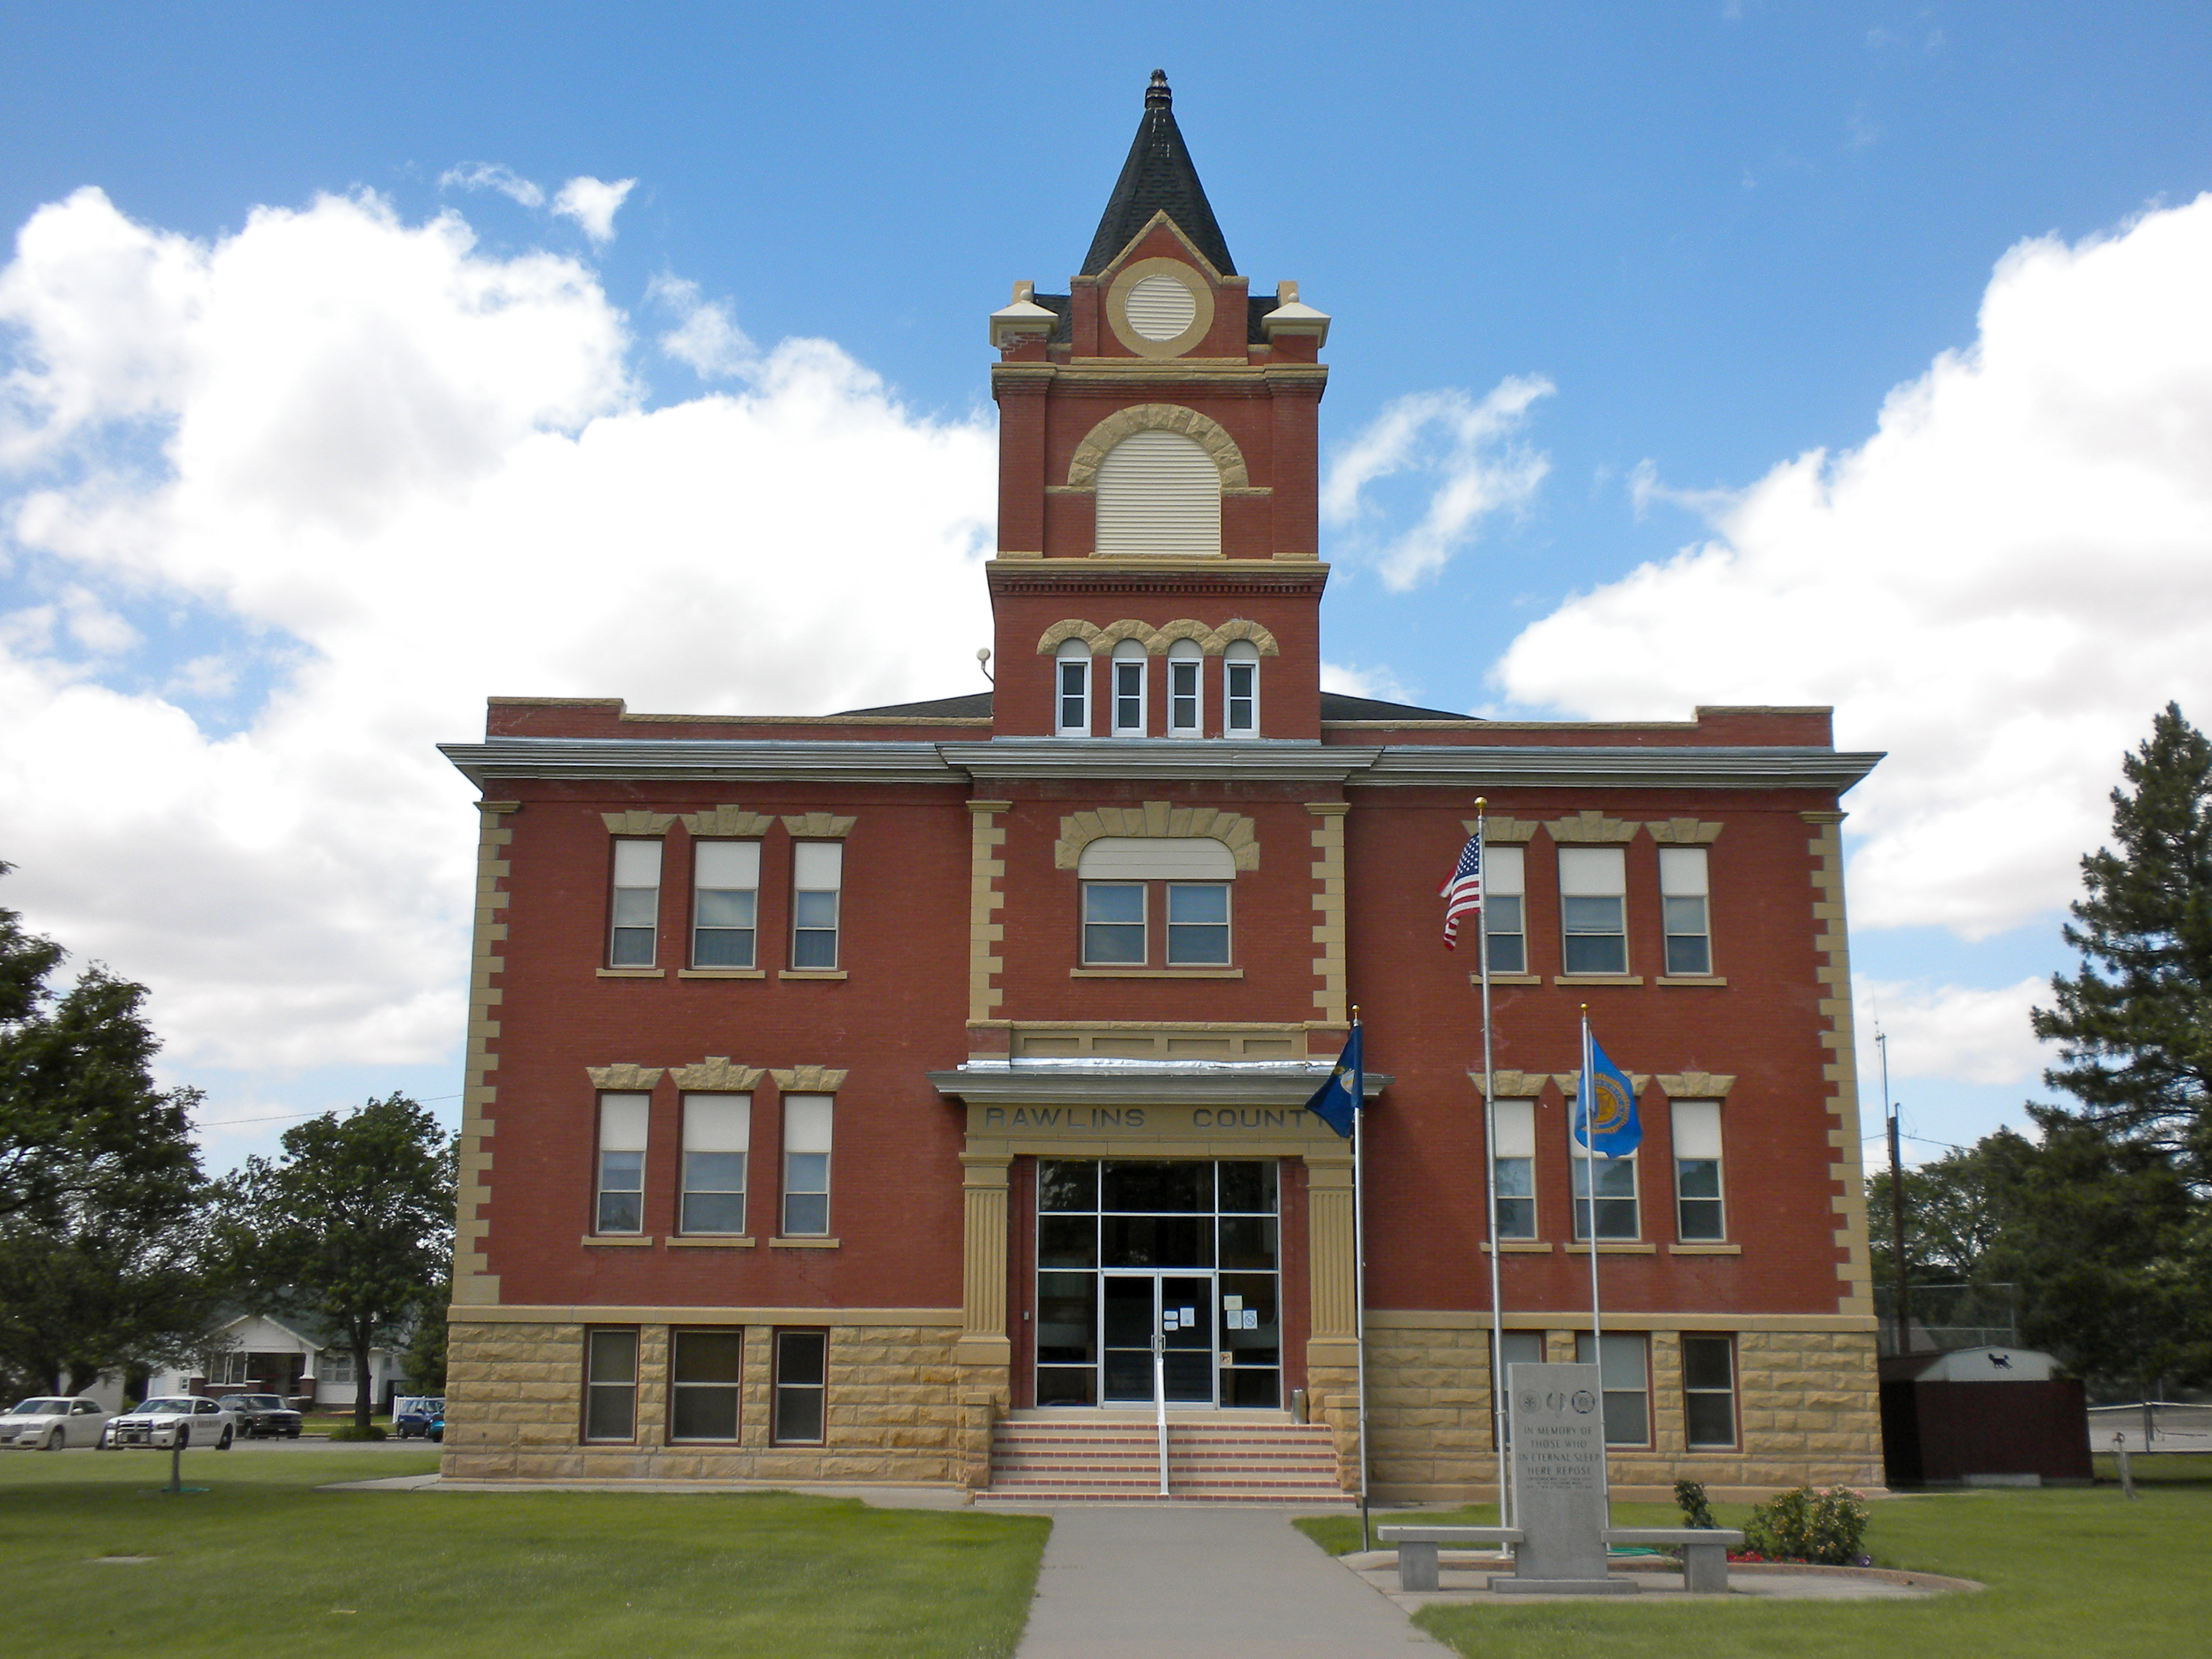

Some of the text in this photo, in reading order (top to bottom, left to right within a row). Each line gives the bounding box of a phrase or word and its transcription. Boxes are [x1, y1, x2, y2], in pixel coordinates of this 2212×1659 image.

[986, 1108, 1145, 1128] RAWLINS
[1537, 1426, 1576, 1434] MEMORY
[1580, 1426, 1591, 1435] OF
[1531, 1440, 1587, 1448] THOSE WHO
[1531, 1453, 1570, 1462] ETERNAL
[1574, 1453, 1600, 1462] SLEEP
[1527, 1467, 1590, 1475] HERE REPOSE
